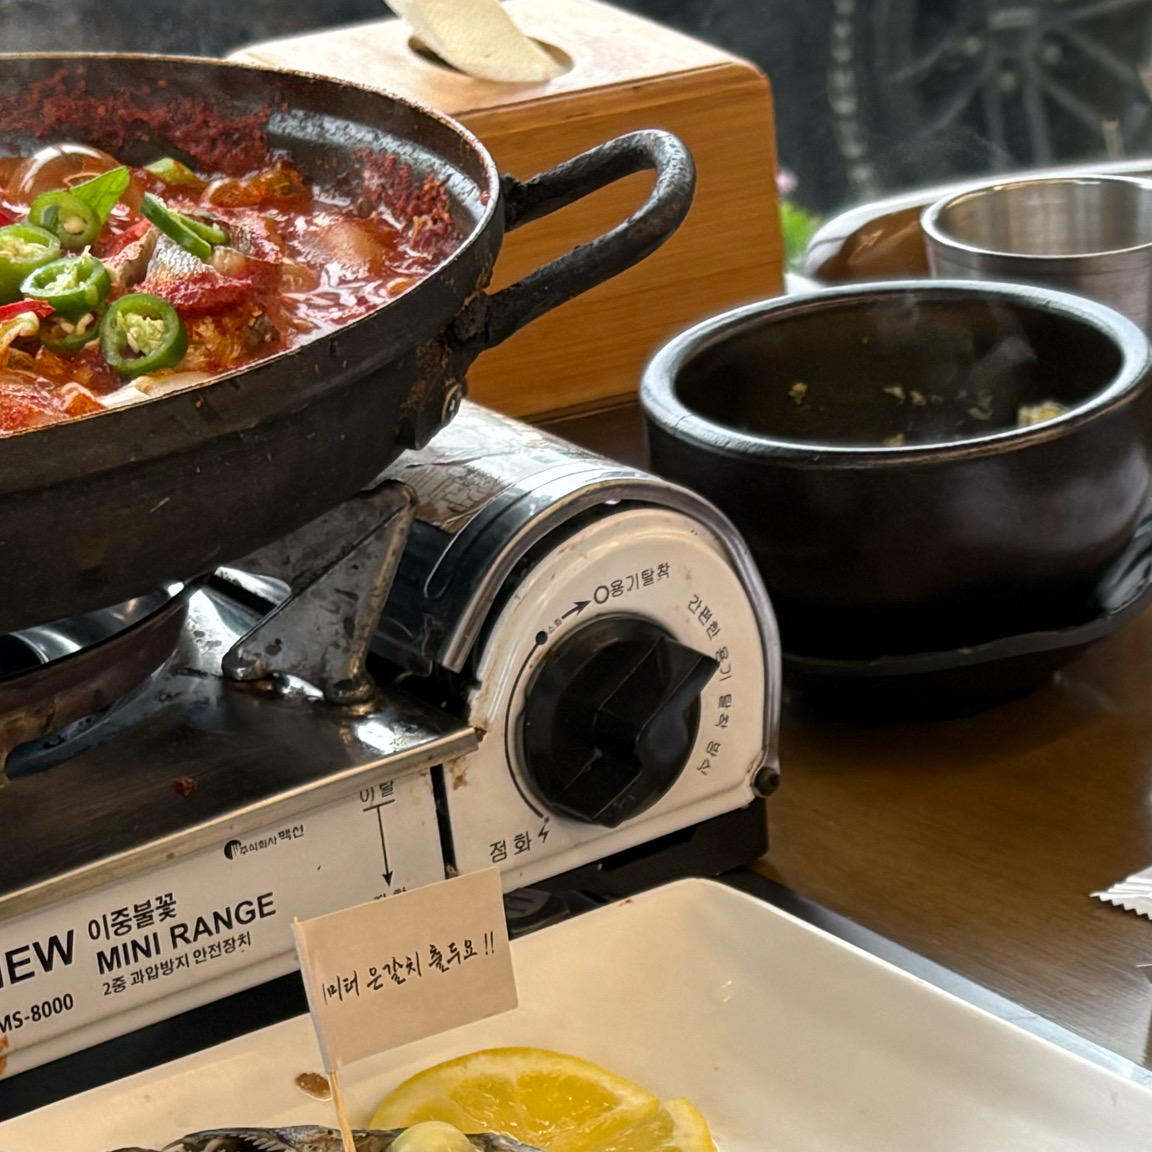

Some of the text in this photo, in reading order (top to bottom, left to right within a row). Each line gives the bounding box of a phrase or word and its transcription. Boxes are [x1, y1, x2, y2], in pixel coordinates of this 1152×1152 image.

[610, 562, 671, 598] 용기탈착
[687, 594, 721, 641] 간편한
[489, 830, 532, 863] 점화
[88, 893, 177, 941] 이중불꽃
[96, 892, 277, 975] MINI RANGE
[0, 929, 74, 988] EW
[102, 931, 251, 996] 2중 과압방지 안전장치
[366, 951, 422, 991] 은갈치
